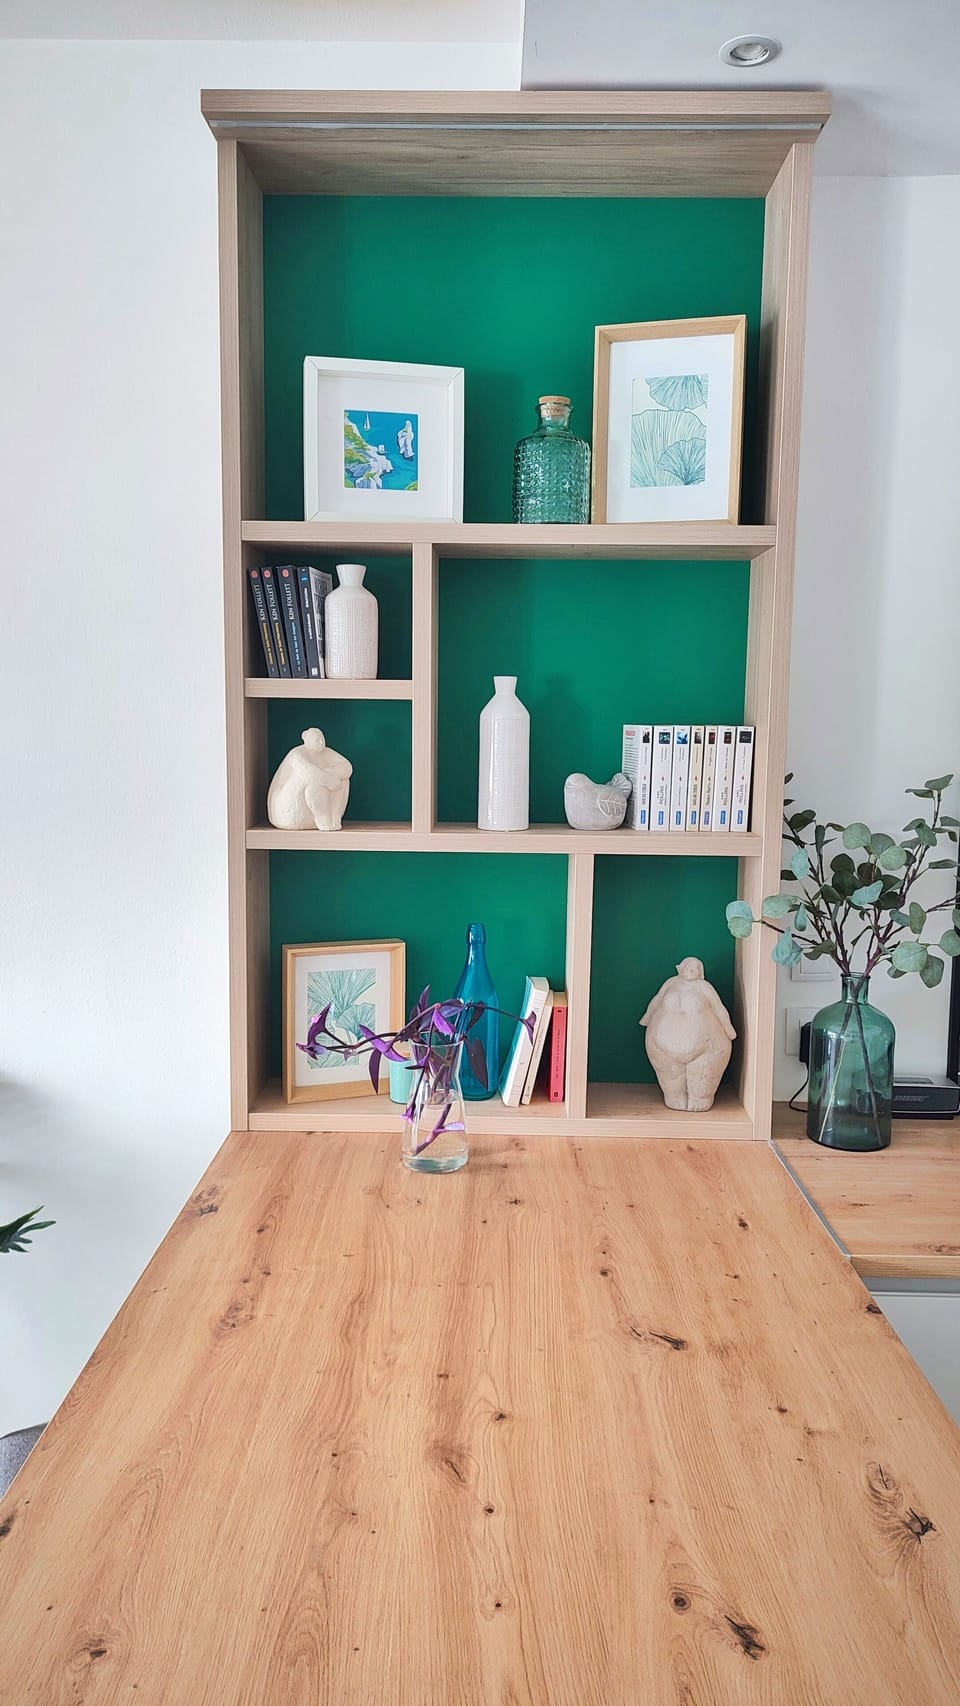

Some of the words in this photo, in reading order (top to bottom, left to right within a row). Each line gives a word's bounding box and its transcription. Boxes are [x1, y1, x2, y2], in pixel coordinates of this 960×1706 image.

[254, 584, 263, 607] FOLLETT
[266, 584, 276, 607] FOLLETT
[284, 583, 294, 607] FOLLETT
[259, 608, 267, 621] KEN
[271, 608, 279, 620] KEN
